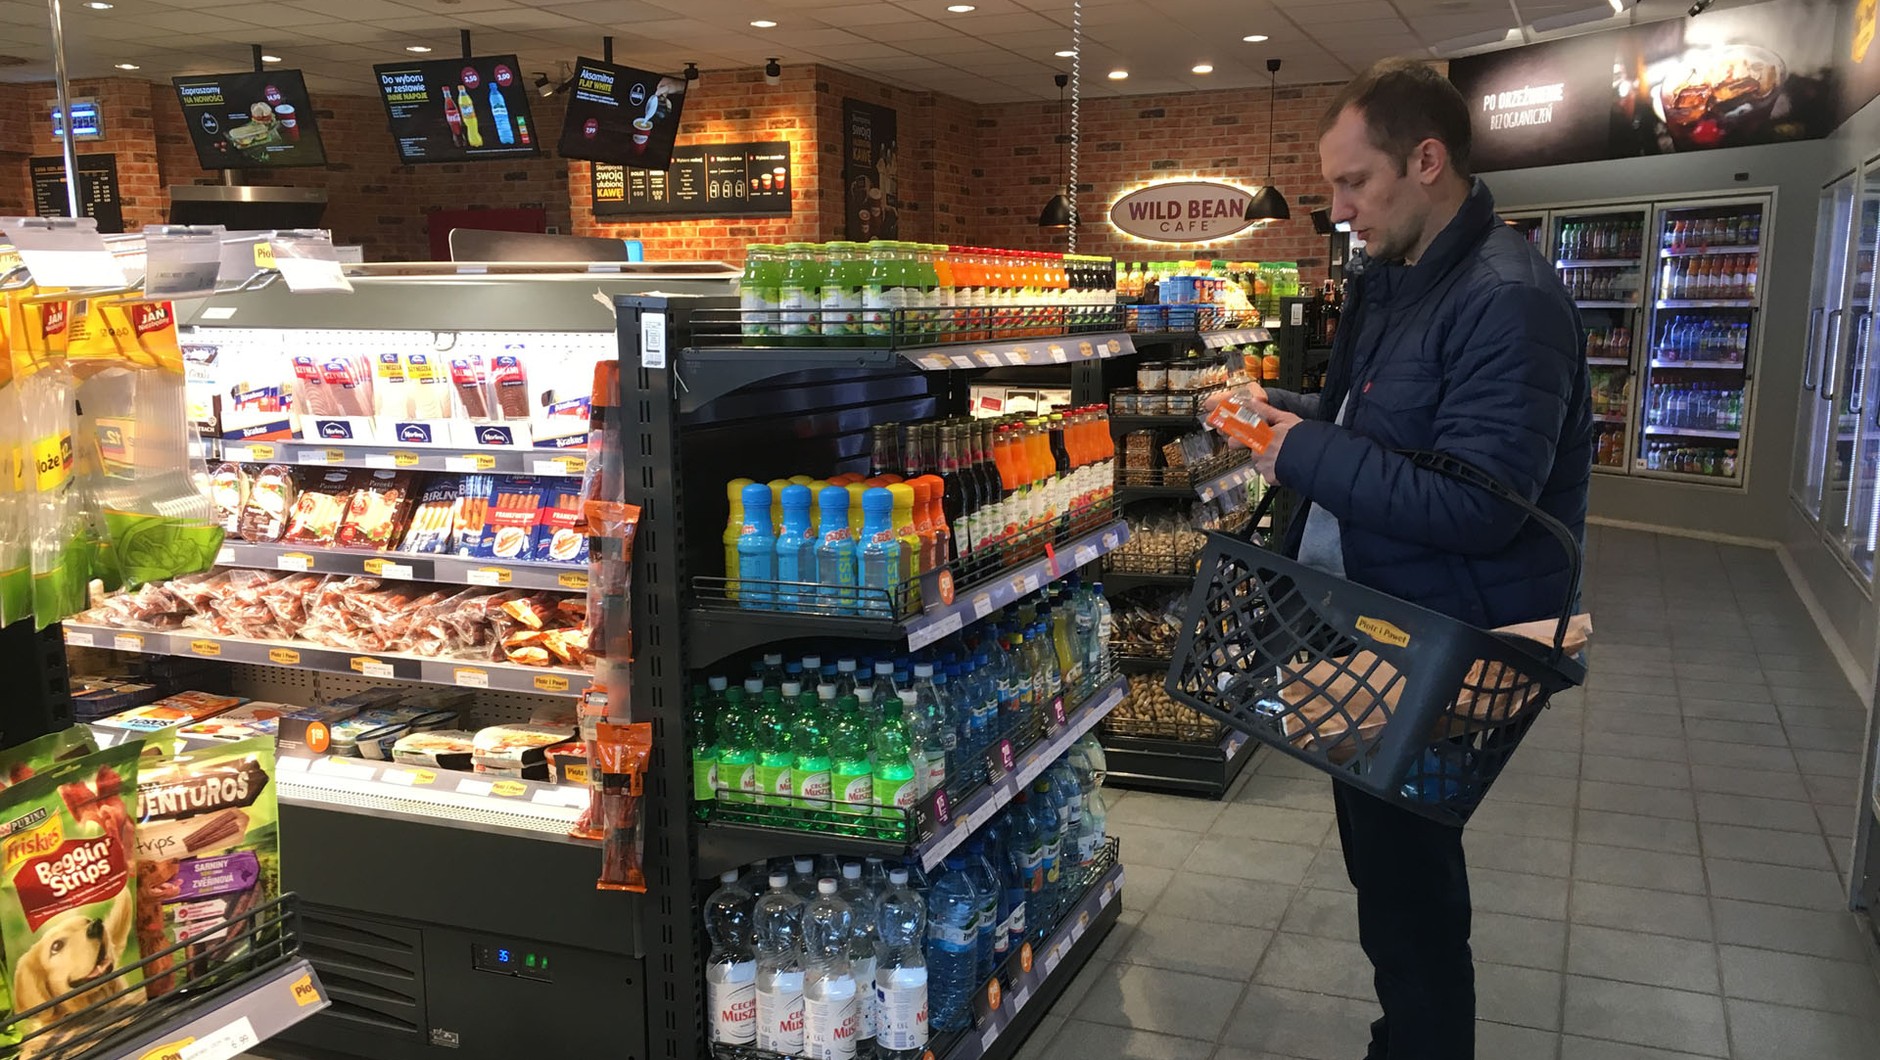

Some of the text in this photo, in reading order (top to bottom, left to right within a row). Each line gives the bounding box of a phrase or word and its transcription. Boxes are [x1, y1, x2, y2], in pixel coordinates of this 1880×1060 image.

[381, 74, 424, 85] Do wyboru
[580, 69, 614, 83] Aksamitna
[181, 87, 221, 96] Zapraszamy
[393, 84, 426, 92] zestawie
[578, 79, 613, 92] FLAT WHITE
[194, 95, 224, 104] NOWOŚCI
[404, 92, 428, 101] NAPOJE
[1484, 94, 1497, 111] PO
[1491, 103, 1554, 130] BEZ OGRANICZEŃ
[596, 171, 623, 182] swoją
[596, 181, 623, 189] ulubioną
[597, 188, 624, 199] KAWĘ!
[1129, 198, 1244, 221] WILD BEAN
[1160, 221, 1209, 232] CAFE
[48, 311, 63, 325] JAN
[141, 308, 165, 324] JAN
[555, 434, 584, 448] Krakus
[1359, 618, 1377, 632] Piotr
[1383, 629, 1407, 643] Paweł
[12, 809, 47, 831] PURINA
[7, 828, 60, 863] Friskies
[49, 859, 111, 897] Strips
